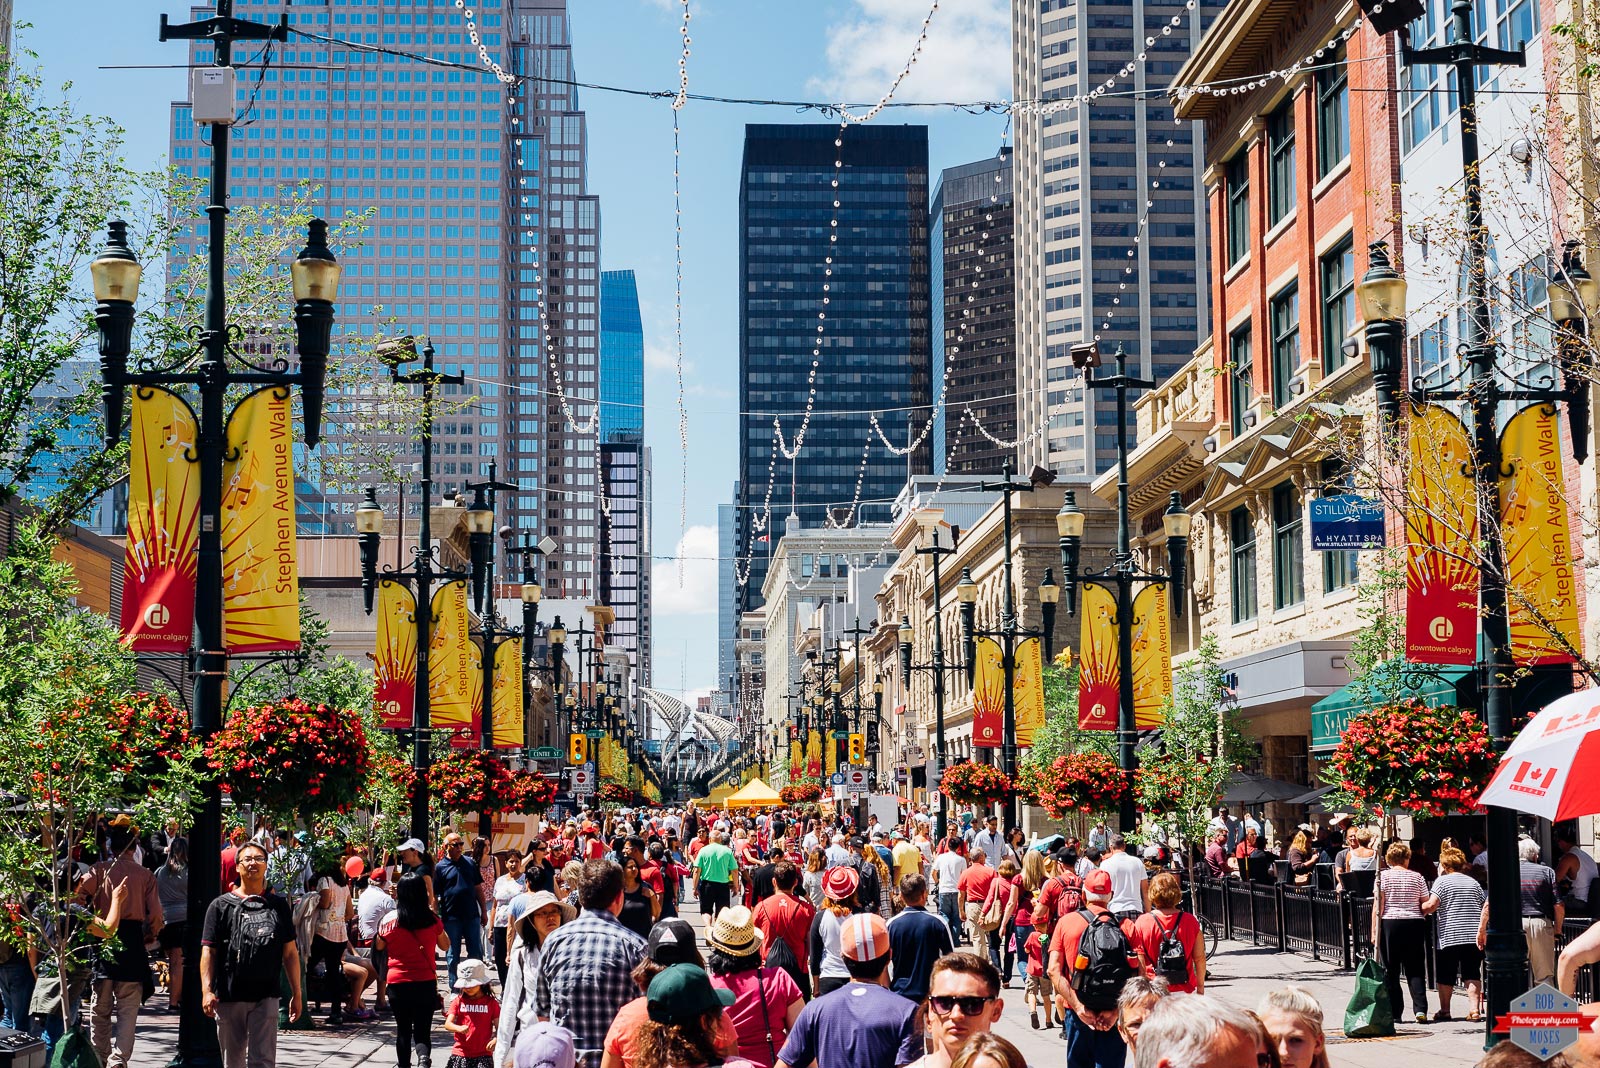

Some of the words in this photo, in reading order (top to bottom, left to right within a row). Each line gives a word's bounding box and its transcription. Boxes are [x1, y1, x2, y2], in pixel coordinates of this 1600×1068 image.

[269, 396, 286, 440] Walk
[1536, 413, 1554, 457] Walk
[273, 443, 290, 511] Avenue
[1544, 460, 1562, 526] Avenue
[1315, 504, 1380, 515] STILLWATER
[274, 517, 295, 594] Stephen
[1551, 533, 1572, 607] Stephen
[163, 633, 189, 643] calgary
[457, 611, 466, 650] Avenue
[1159, 615, 1167, 653] Avenue
[1409, 643, 1447, 652] downtown
[1447, 645, 1473, 655] calgary
[457, 651, 468, 696] Stephen
[513, 661, 521, 690] Avenue
[1032, 664, 1042, 690] Avenue
[513, 691, 522, 725] Stephen
[1033, 692, 1044, 724] Stephen
[906, 722, 914, 755] HOME
[460, 1003, 489, 1013] CANADA
